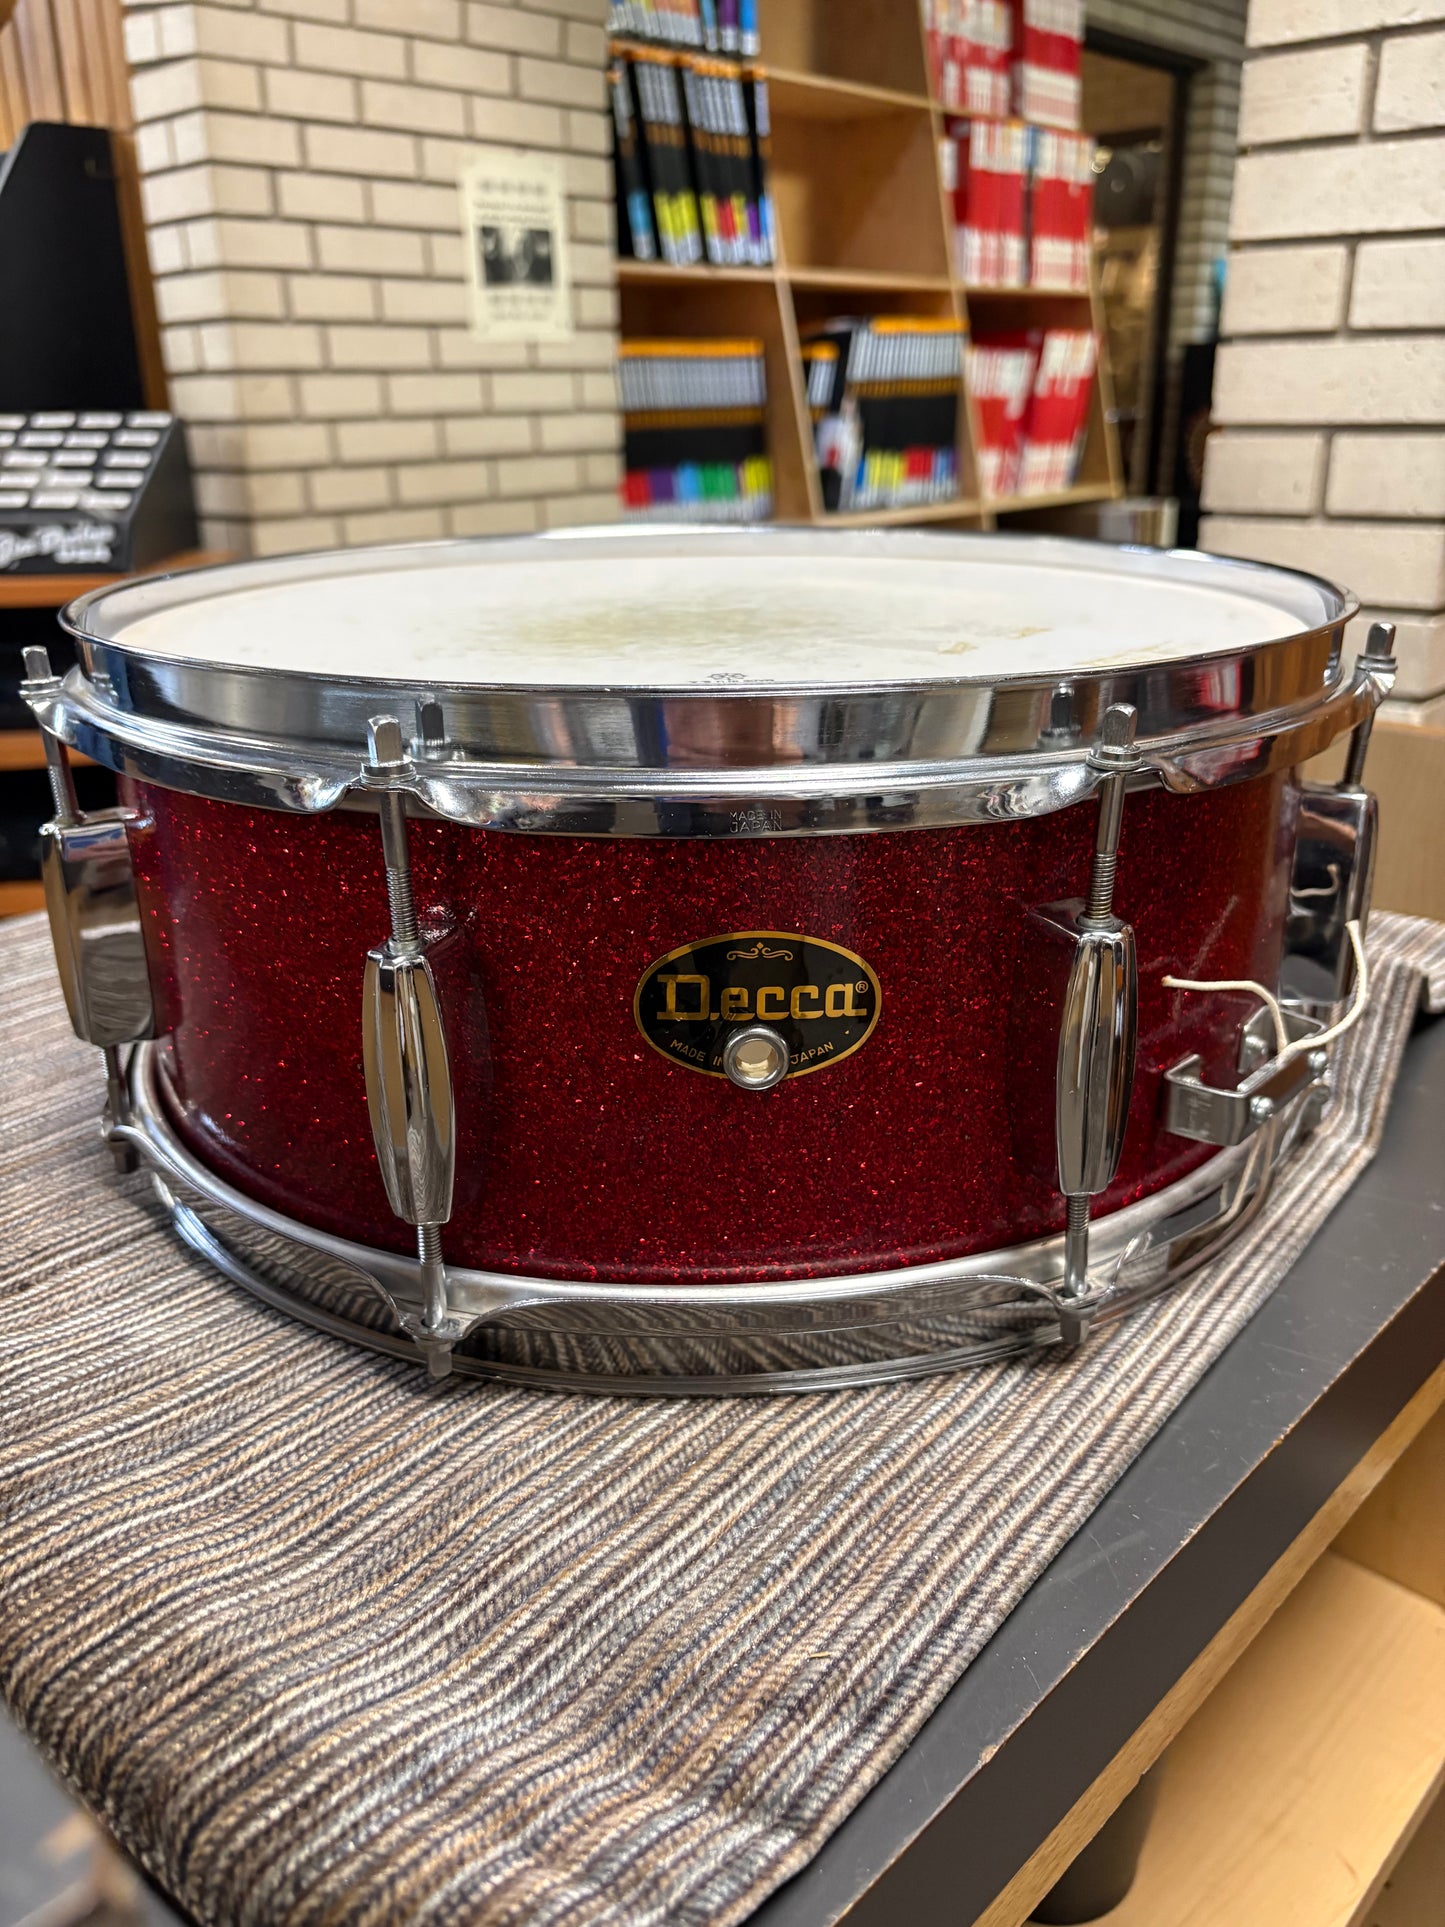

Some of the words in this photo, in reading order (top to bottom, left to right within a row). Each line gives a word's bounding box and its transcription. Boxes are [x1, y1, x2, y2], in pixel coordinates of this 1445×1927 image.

[730, 810, 766, 821] MADE
[770, 809, 782, 820] IN
[730, 820, 782, 833] JAPAN
[670, 1039, 706, 1062] MADE
[790, 1041, 834, 1065] JAPAN
